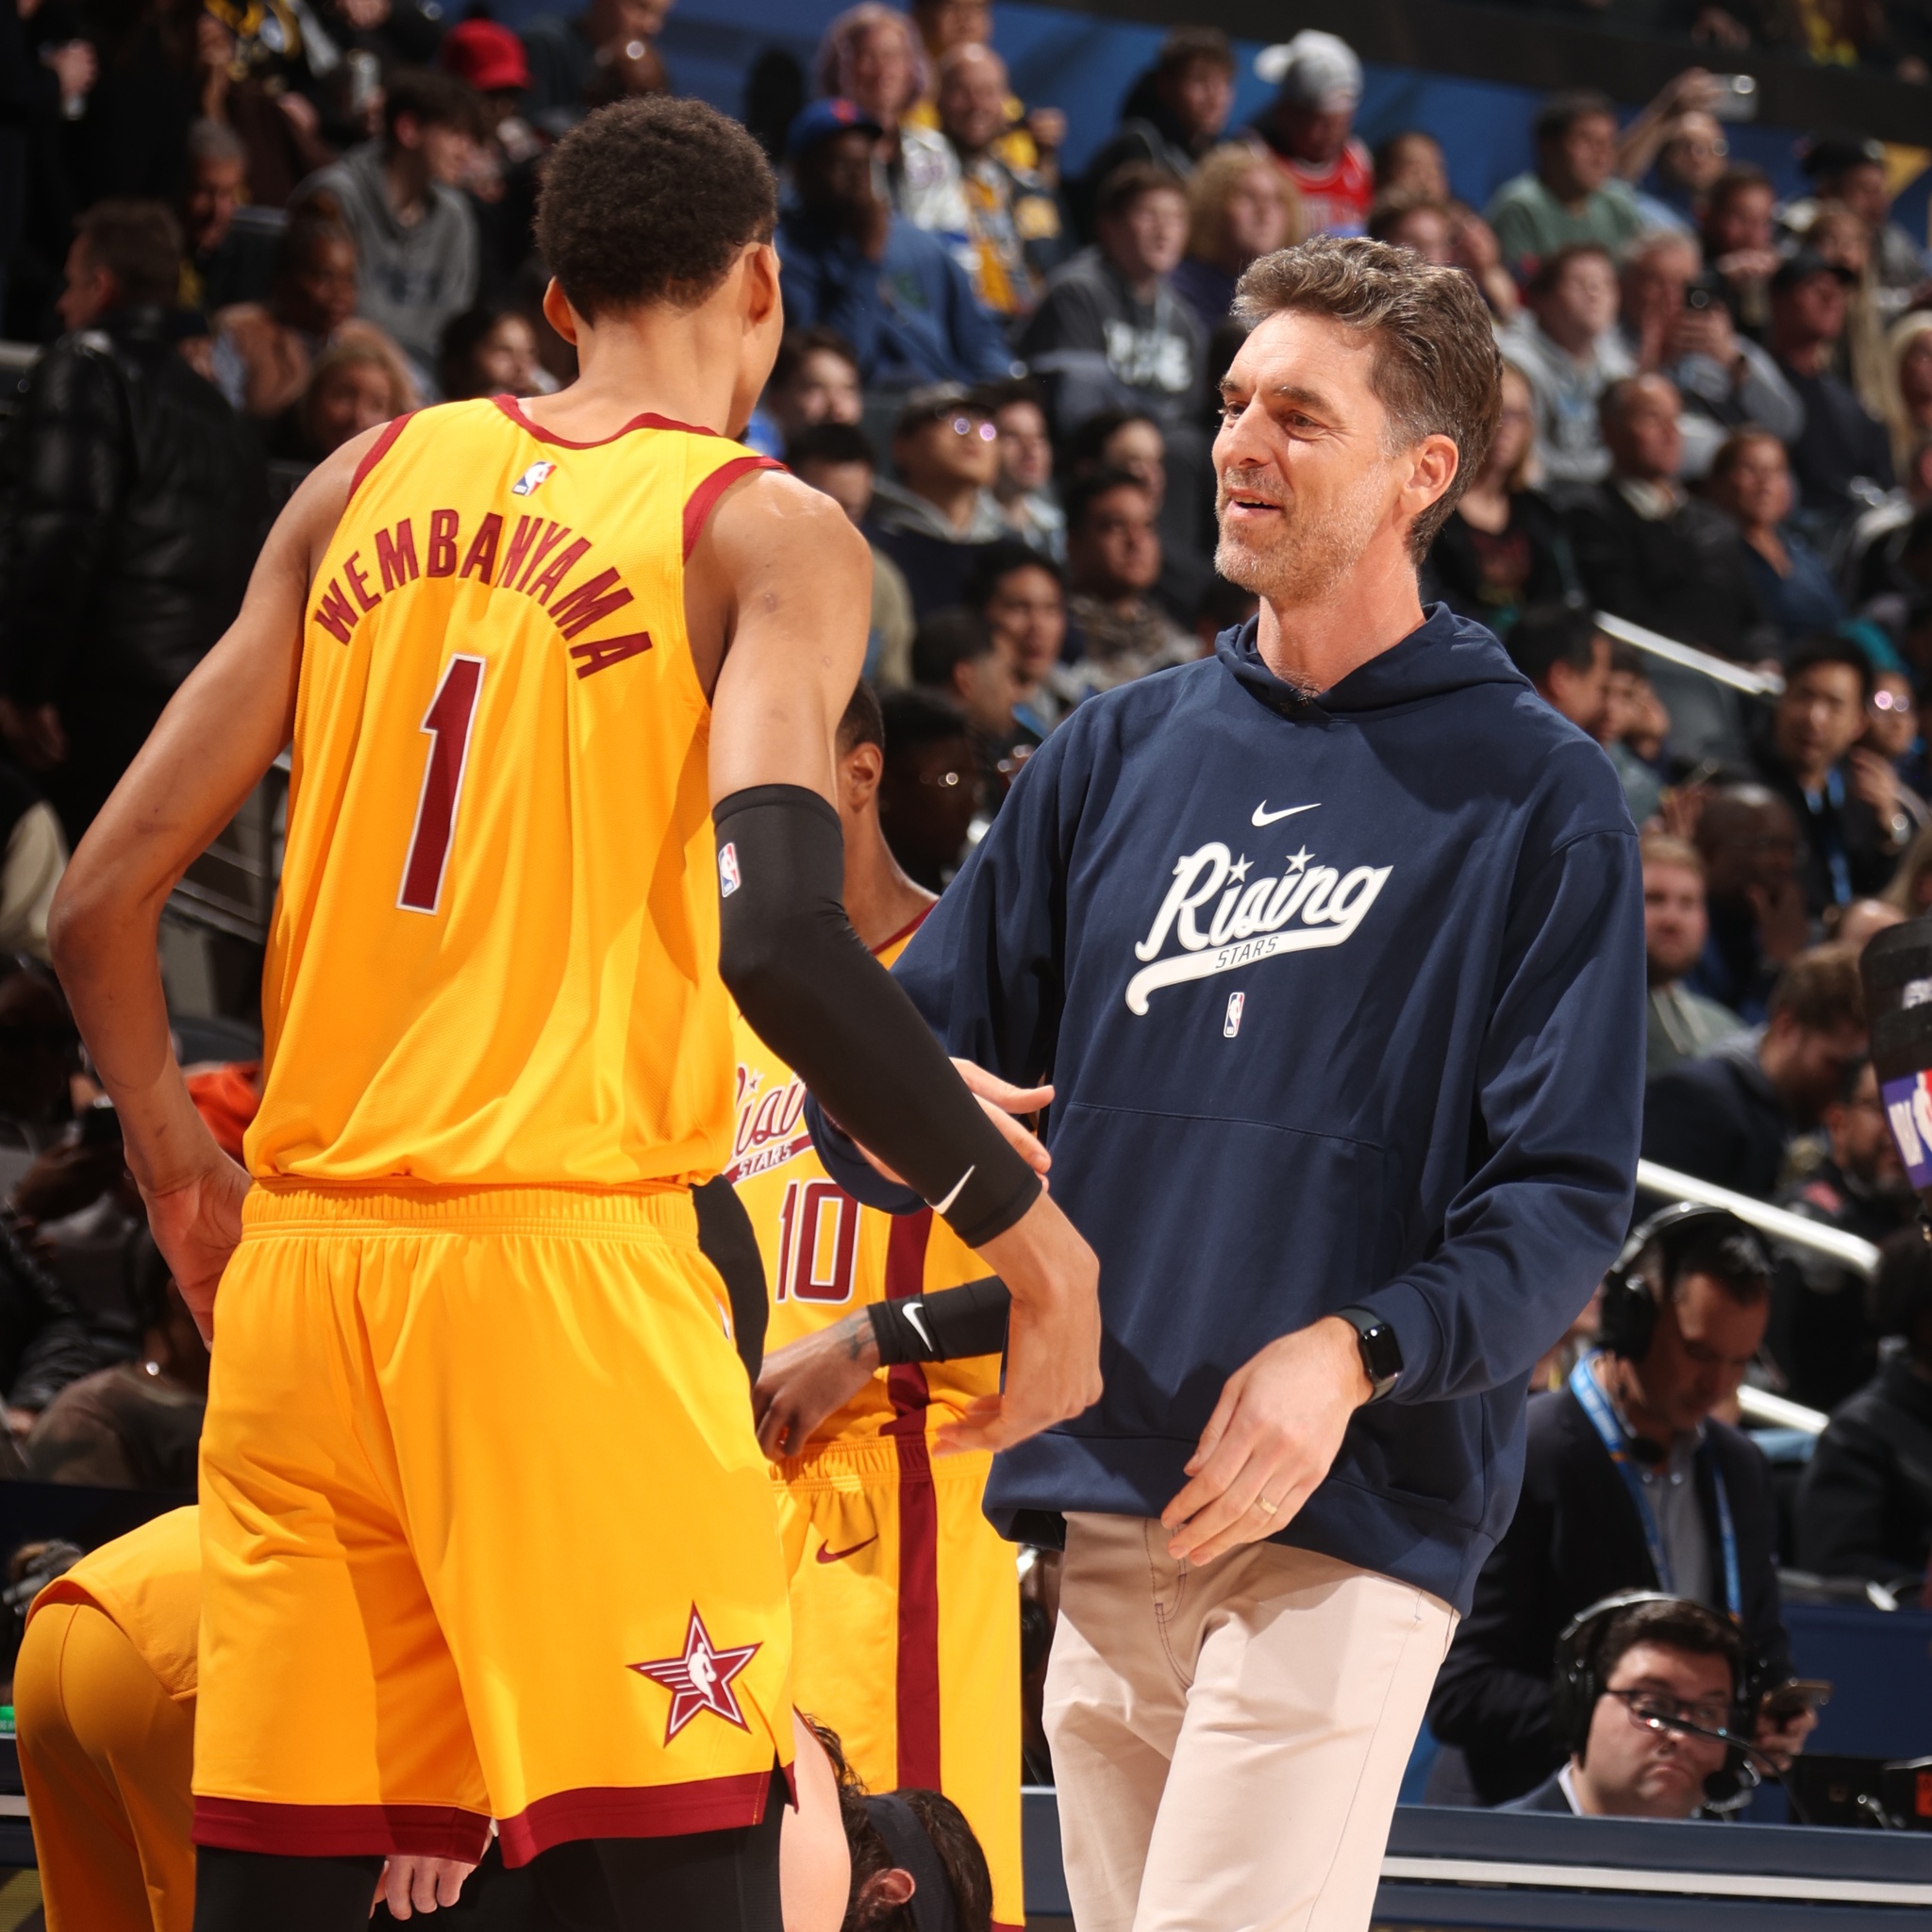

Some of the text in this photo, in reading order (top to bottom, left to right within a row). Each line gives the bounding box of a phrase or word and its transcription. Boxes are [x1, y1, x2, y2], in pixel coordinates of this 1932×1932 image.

[313, 508, 653, 680] WEMBANYAMA
[395, 652, 487, 916] 1
[1135, 841, 1394, 961] Rising
[1215, 936, 1279, 970] STARS
[736, 1142, 793, 1180] STARS
[774, 1179, 862, 1306] 10
